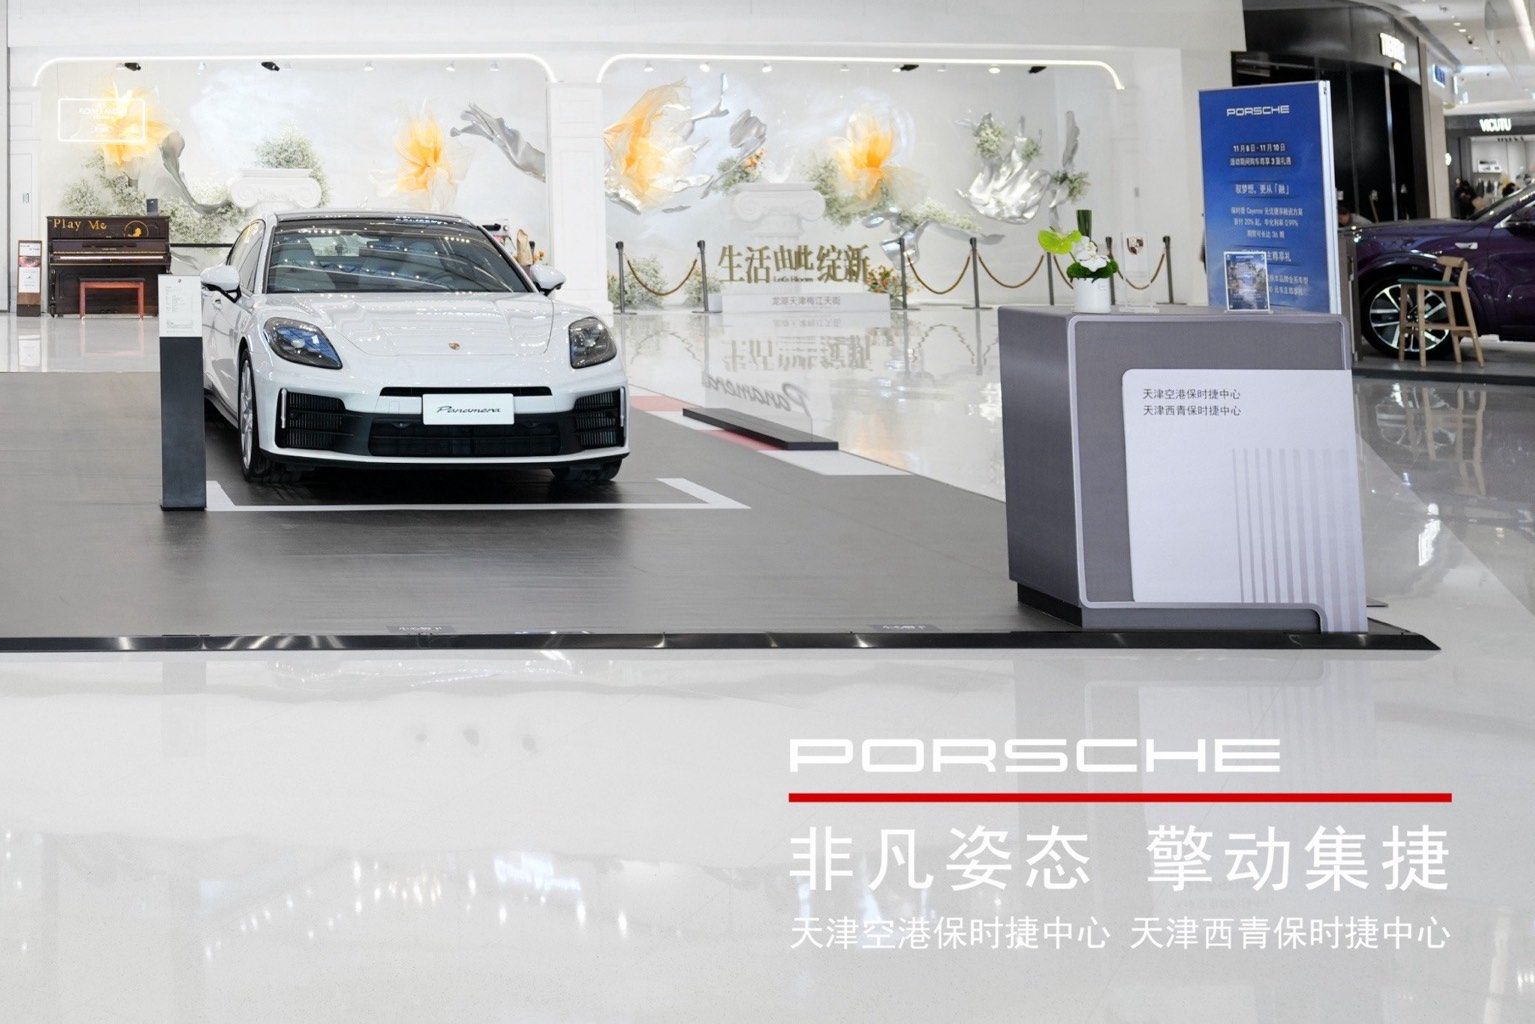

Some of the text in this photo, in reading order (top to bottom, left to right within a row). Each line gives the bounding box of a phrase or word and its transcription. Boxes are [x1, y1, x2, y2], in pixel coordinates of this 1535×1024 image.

[1227, 105, 1290, 116] PORSCHE
[53, 218, 107, 231] Play Me
[1143, 388, 1241, 400] 天津空港保时捷中心
[436, 405, 501, 414] Panamera
[1143, 405, 1242, 416] 天津西青保时捷中心
